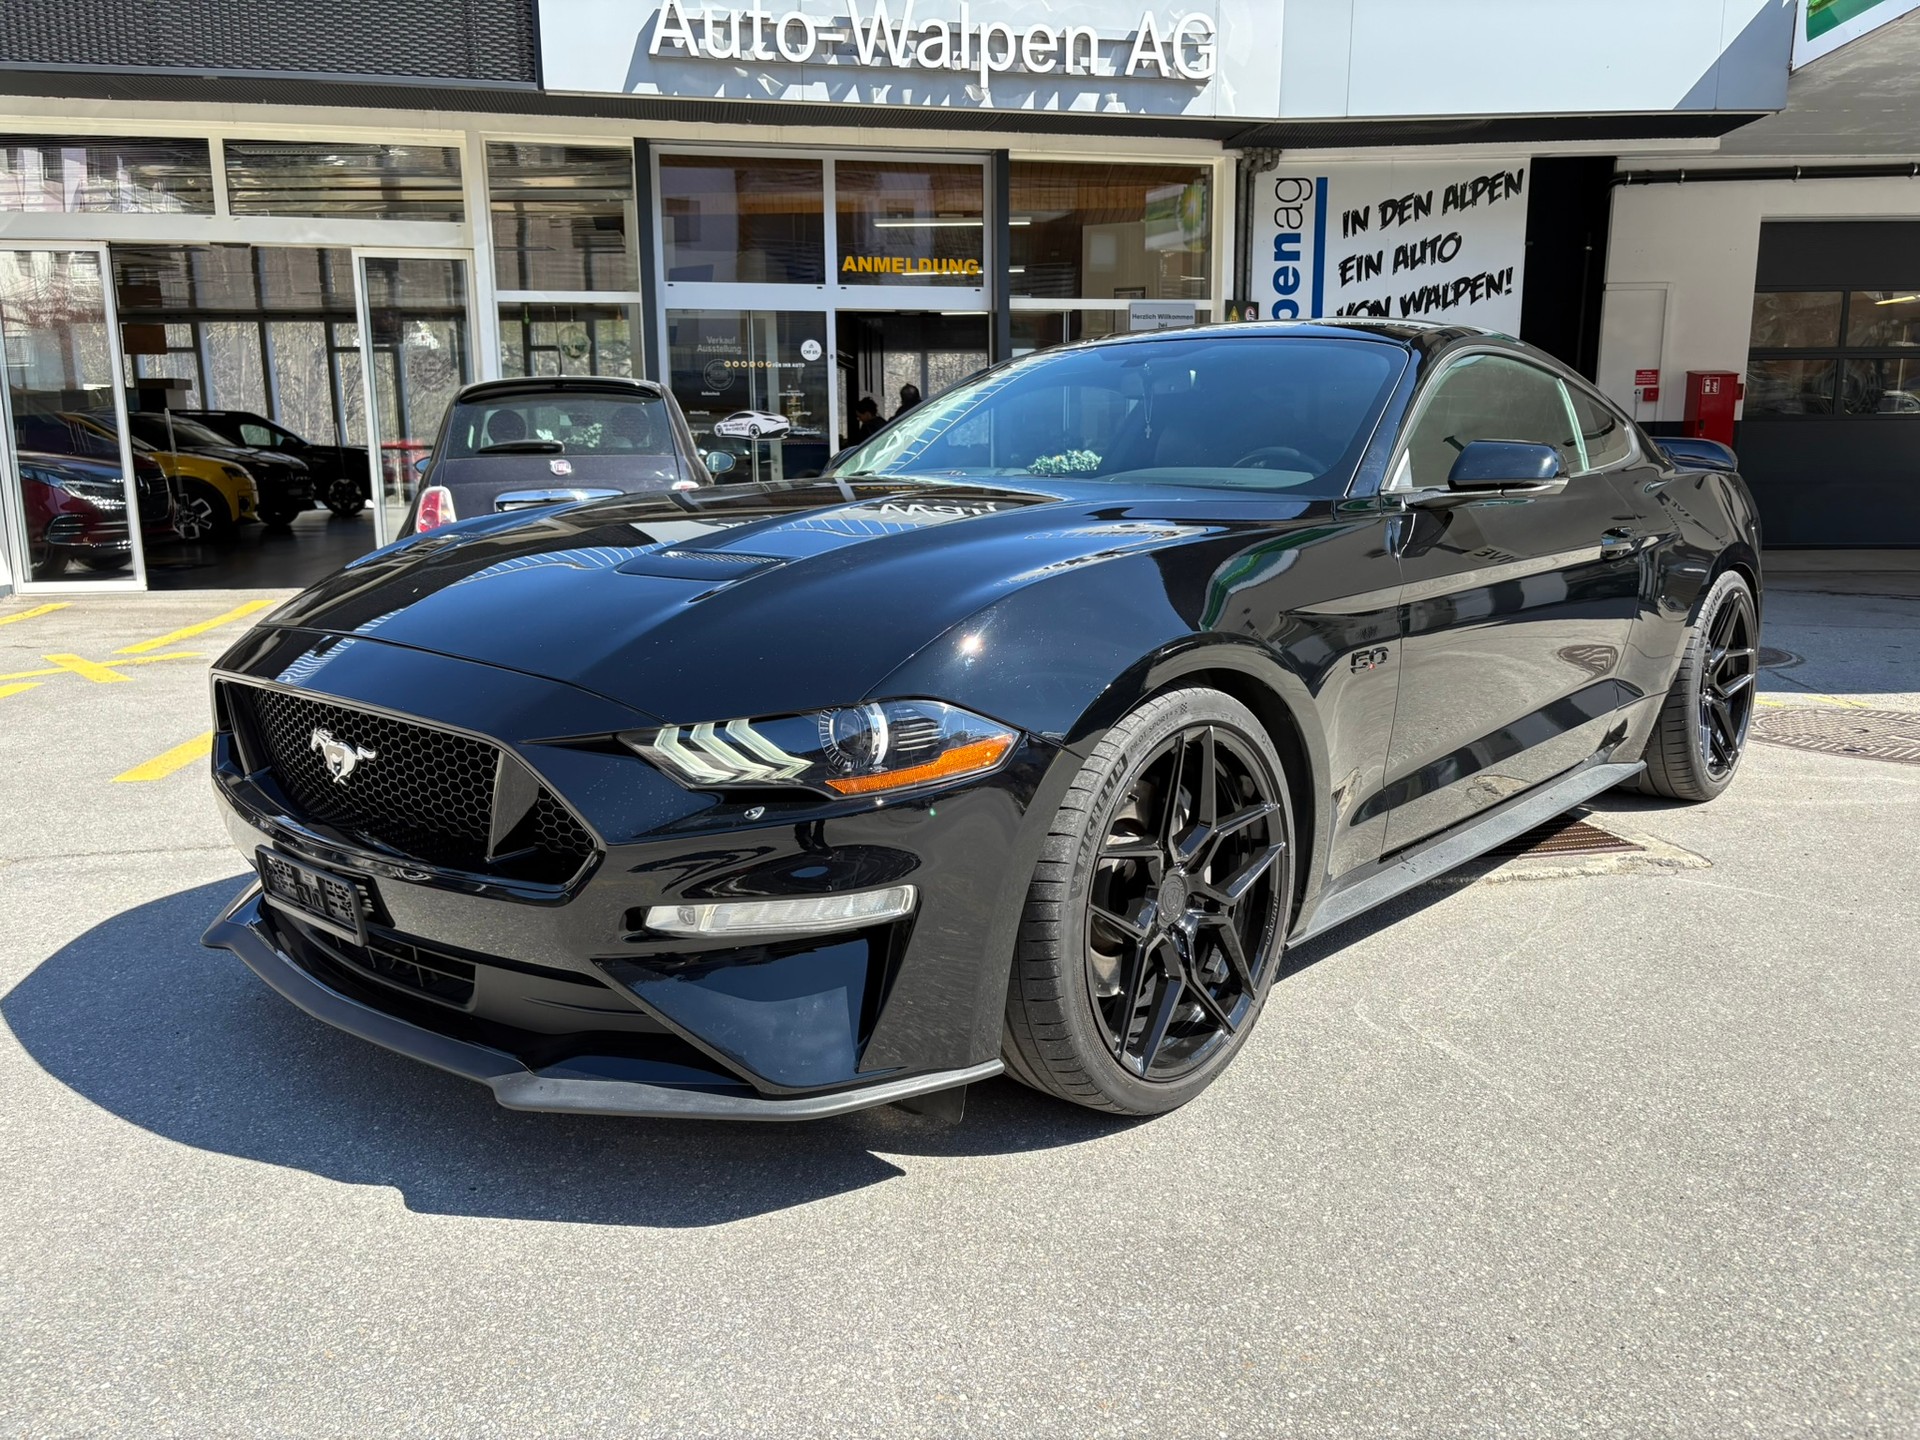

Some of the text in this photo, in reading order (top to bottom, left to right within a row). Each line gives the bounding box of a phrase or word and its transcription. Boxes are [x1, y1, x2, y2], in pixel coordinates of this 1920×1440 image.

[648, 0, 1215, 89] Auto-Walpen AG
[1342, 168, 1524, 239] IN DEN ALPEN
[841, 255, 979, 275] ANMELDUNG
[1337, 231, 1463, 288] EIN AUTO
[1400, 266, 1514, 318] WALPEN!
[696, 344, 742, 355] Ausstellung
[706, 335, 736, 344] Verkauf
[1129, 731, 1148, 753] PILOT
[1149, 713, 1170, 733] SPORT
[1076, 758, 1126, 867] MICHELIN
